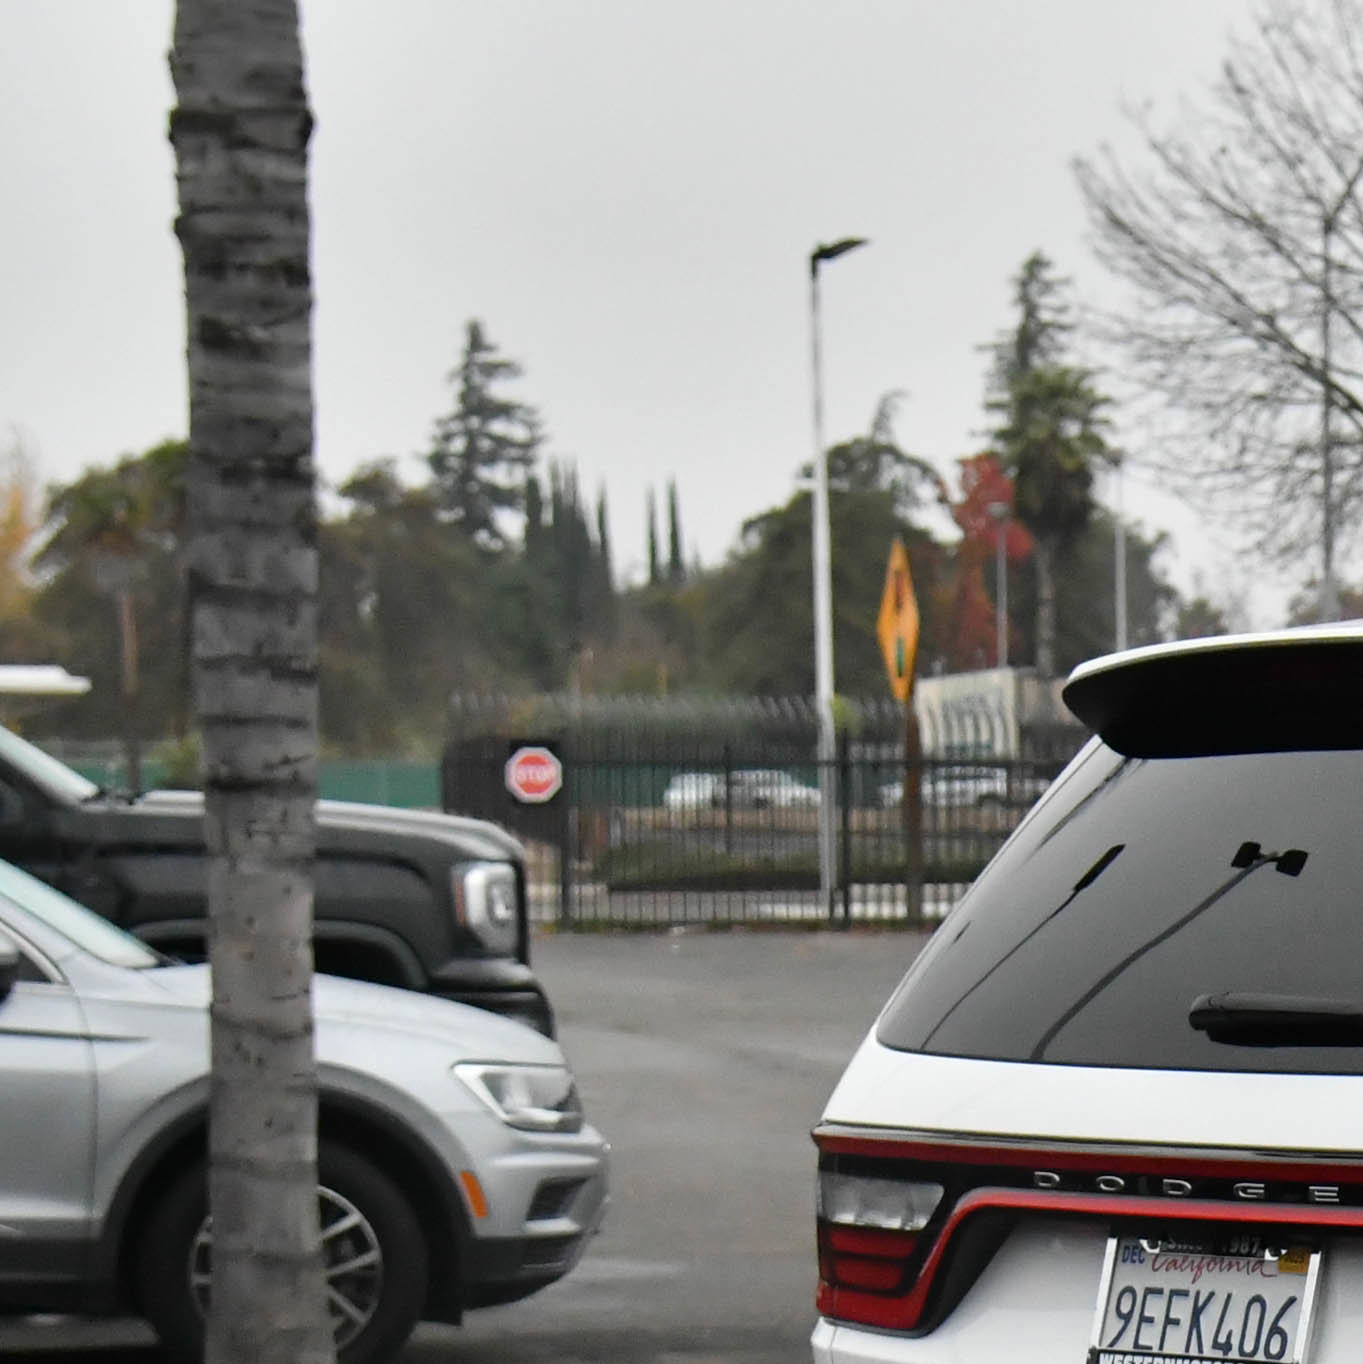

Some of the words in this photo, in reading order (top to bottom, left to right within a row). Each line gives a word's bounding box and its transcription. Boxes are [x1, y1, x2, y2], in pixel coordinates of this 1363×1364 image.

[516, 764, 557, 783] STOP
[1033, 1170, 1340, 1202] DODGE
[1121, 1244, 1146, 1265] DEC
[1106, 1285, 1299, 1361] 9EFK406
